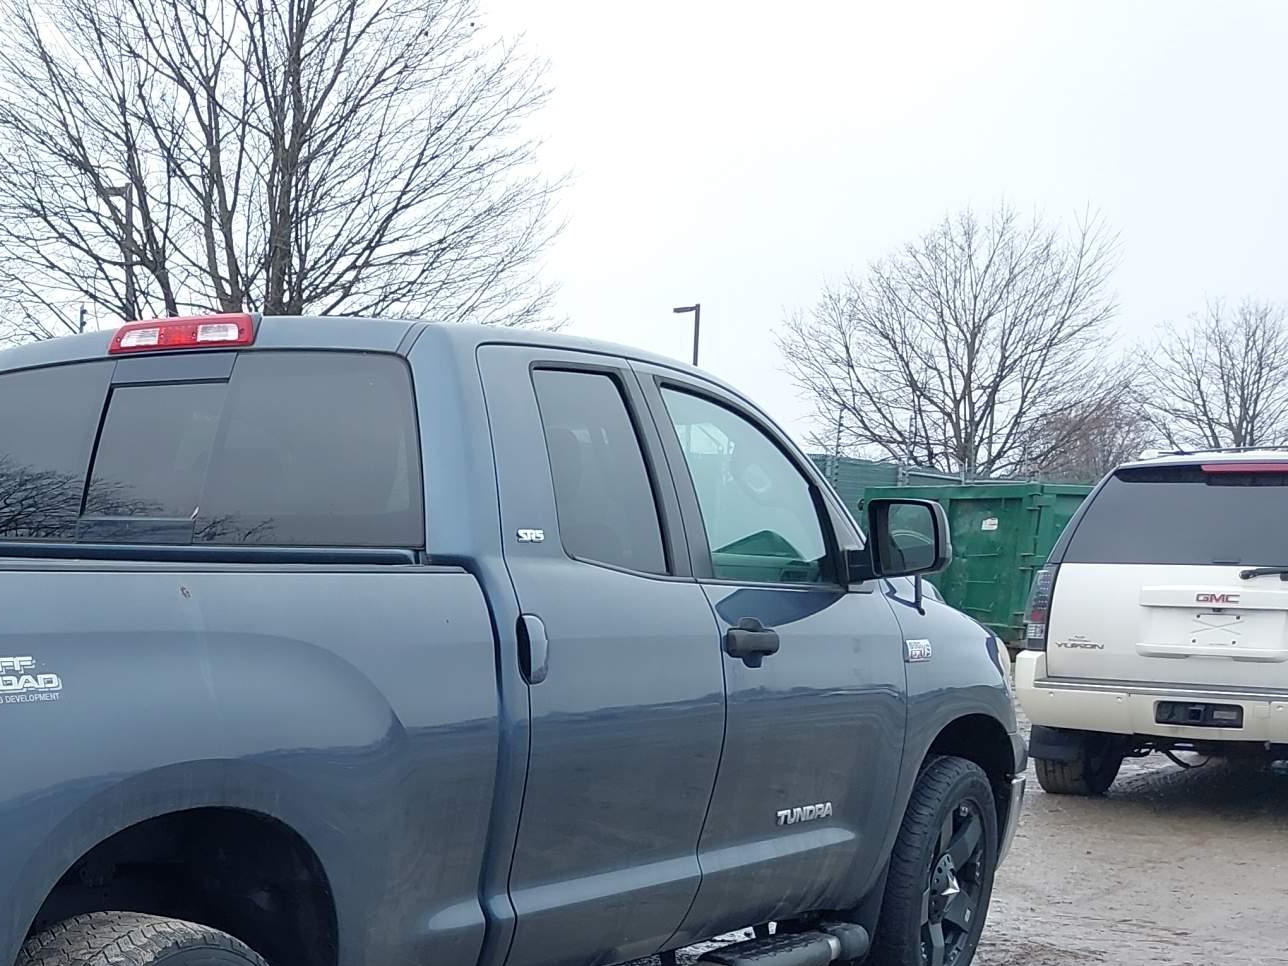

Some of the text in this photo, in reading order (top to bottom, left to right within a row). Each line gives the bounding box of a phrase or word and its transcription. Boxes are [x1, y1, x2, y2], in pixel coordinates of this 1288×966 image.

[1196, 593, 1241, 603] GMC
[1055, 642, 1104, 650] YUKON
[5, 692, 60, 704] DEVELOPMENT
[777, 802, 833, 825] TUNDRA
